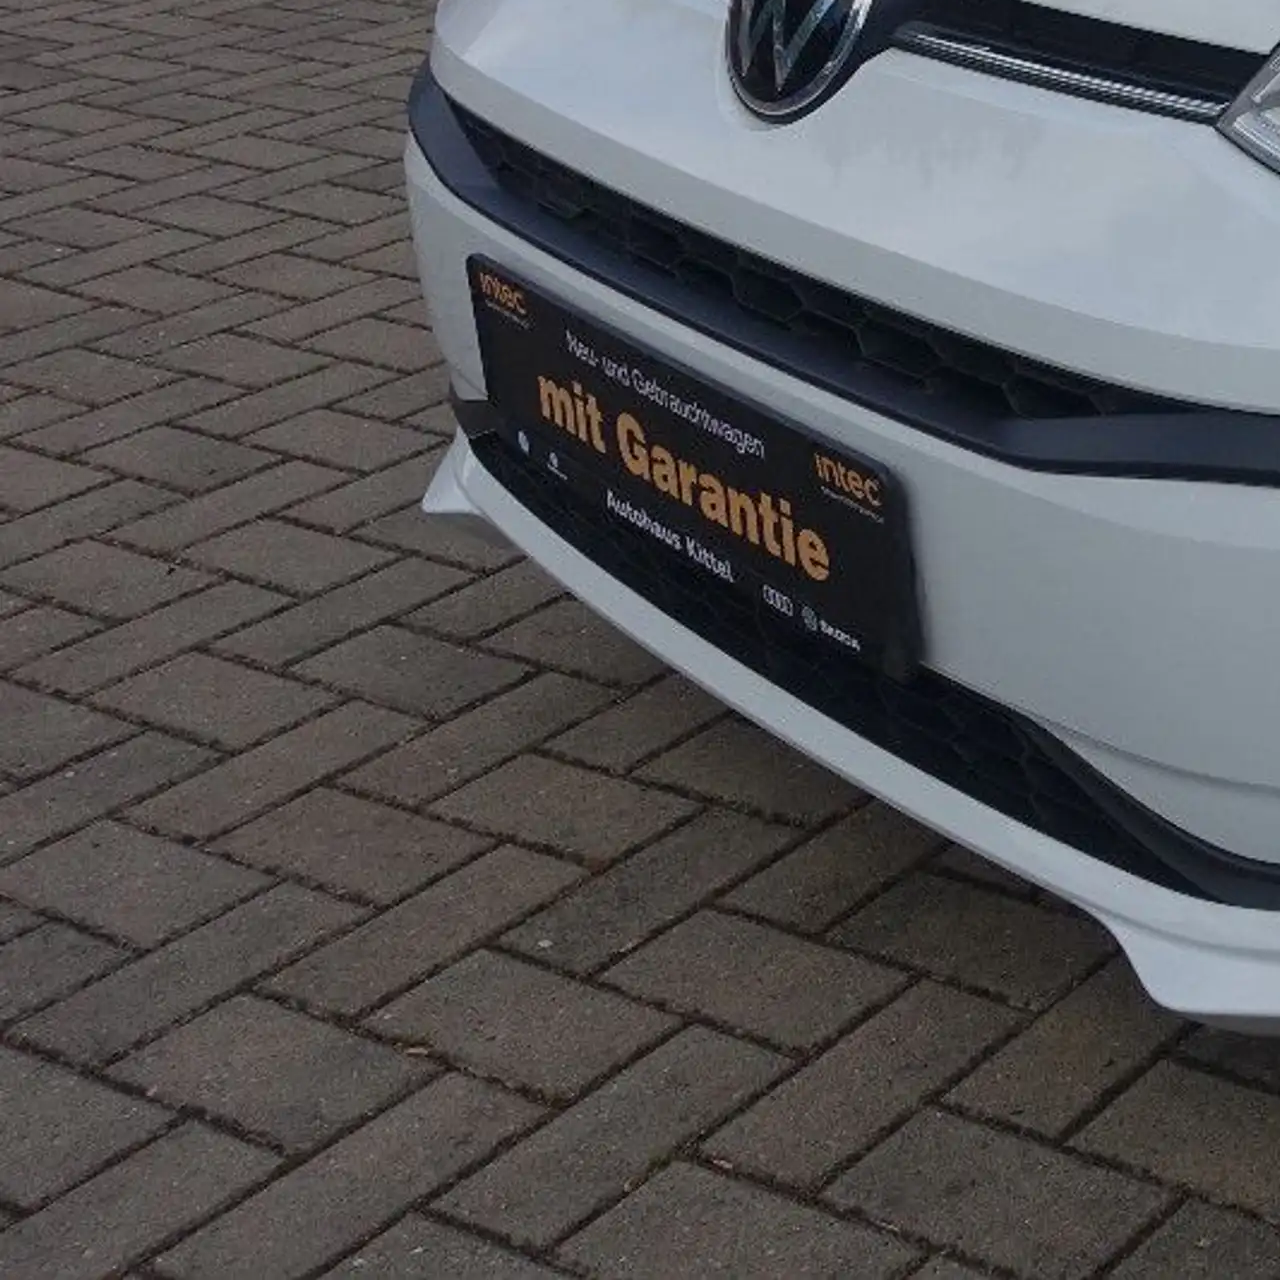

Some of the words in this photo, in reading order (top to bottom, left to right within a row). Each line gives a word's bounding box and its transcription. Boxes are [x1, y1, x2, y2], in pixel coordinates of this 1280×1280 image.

[538, 375, 606, 454] mit
[616, 412, 830, 582] Garantie
[814, 452, 882, 507] intec
[606, 488, 682, 550] Autohaus
